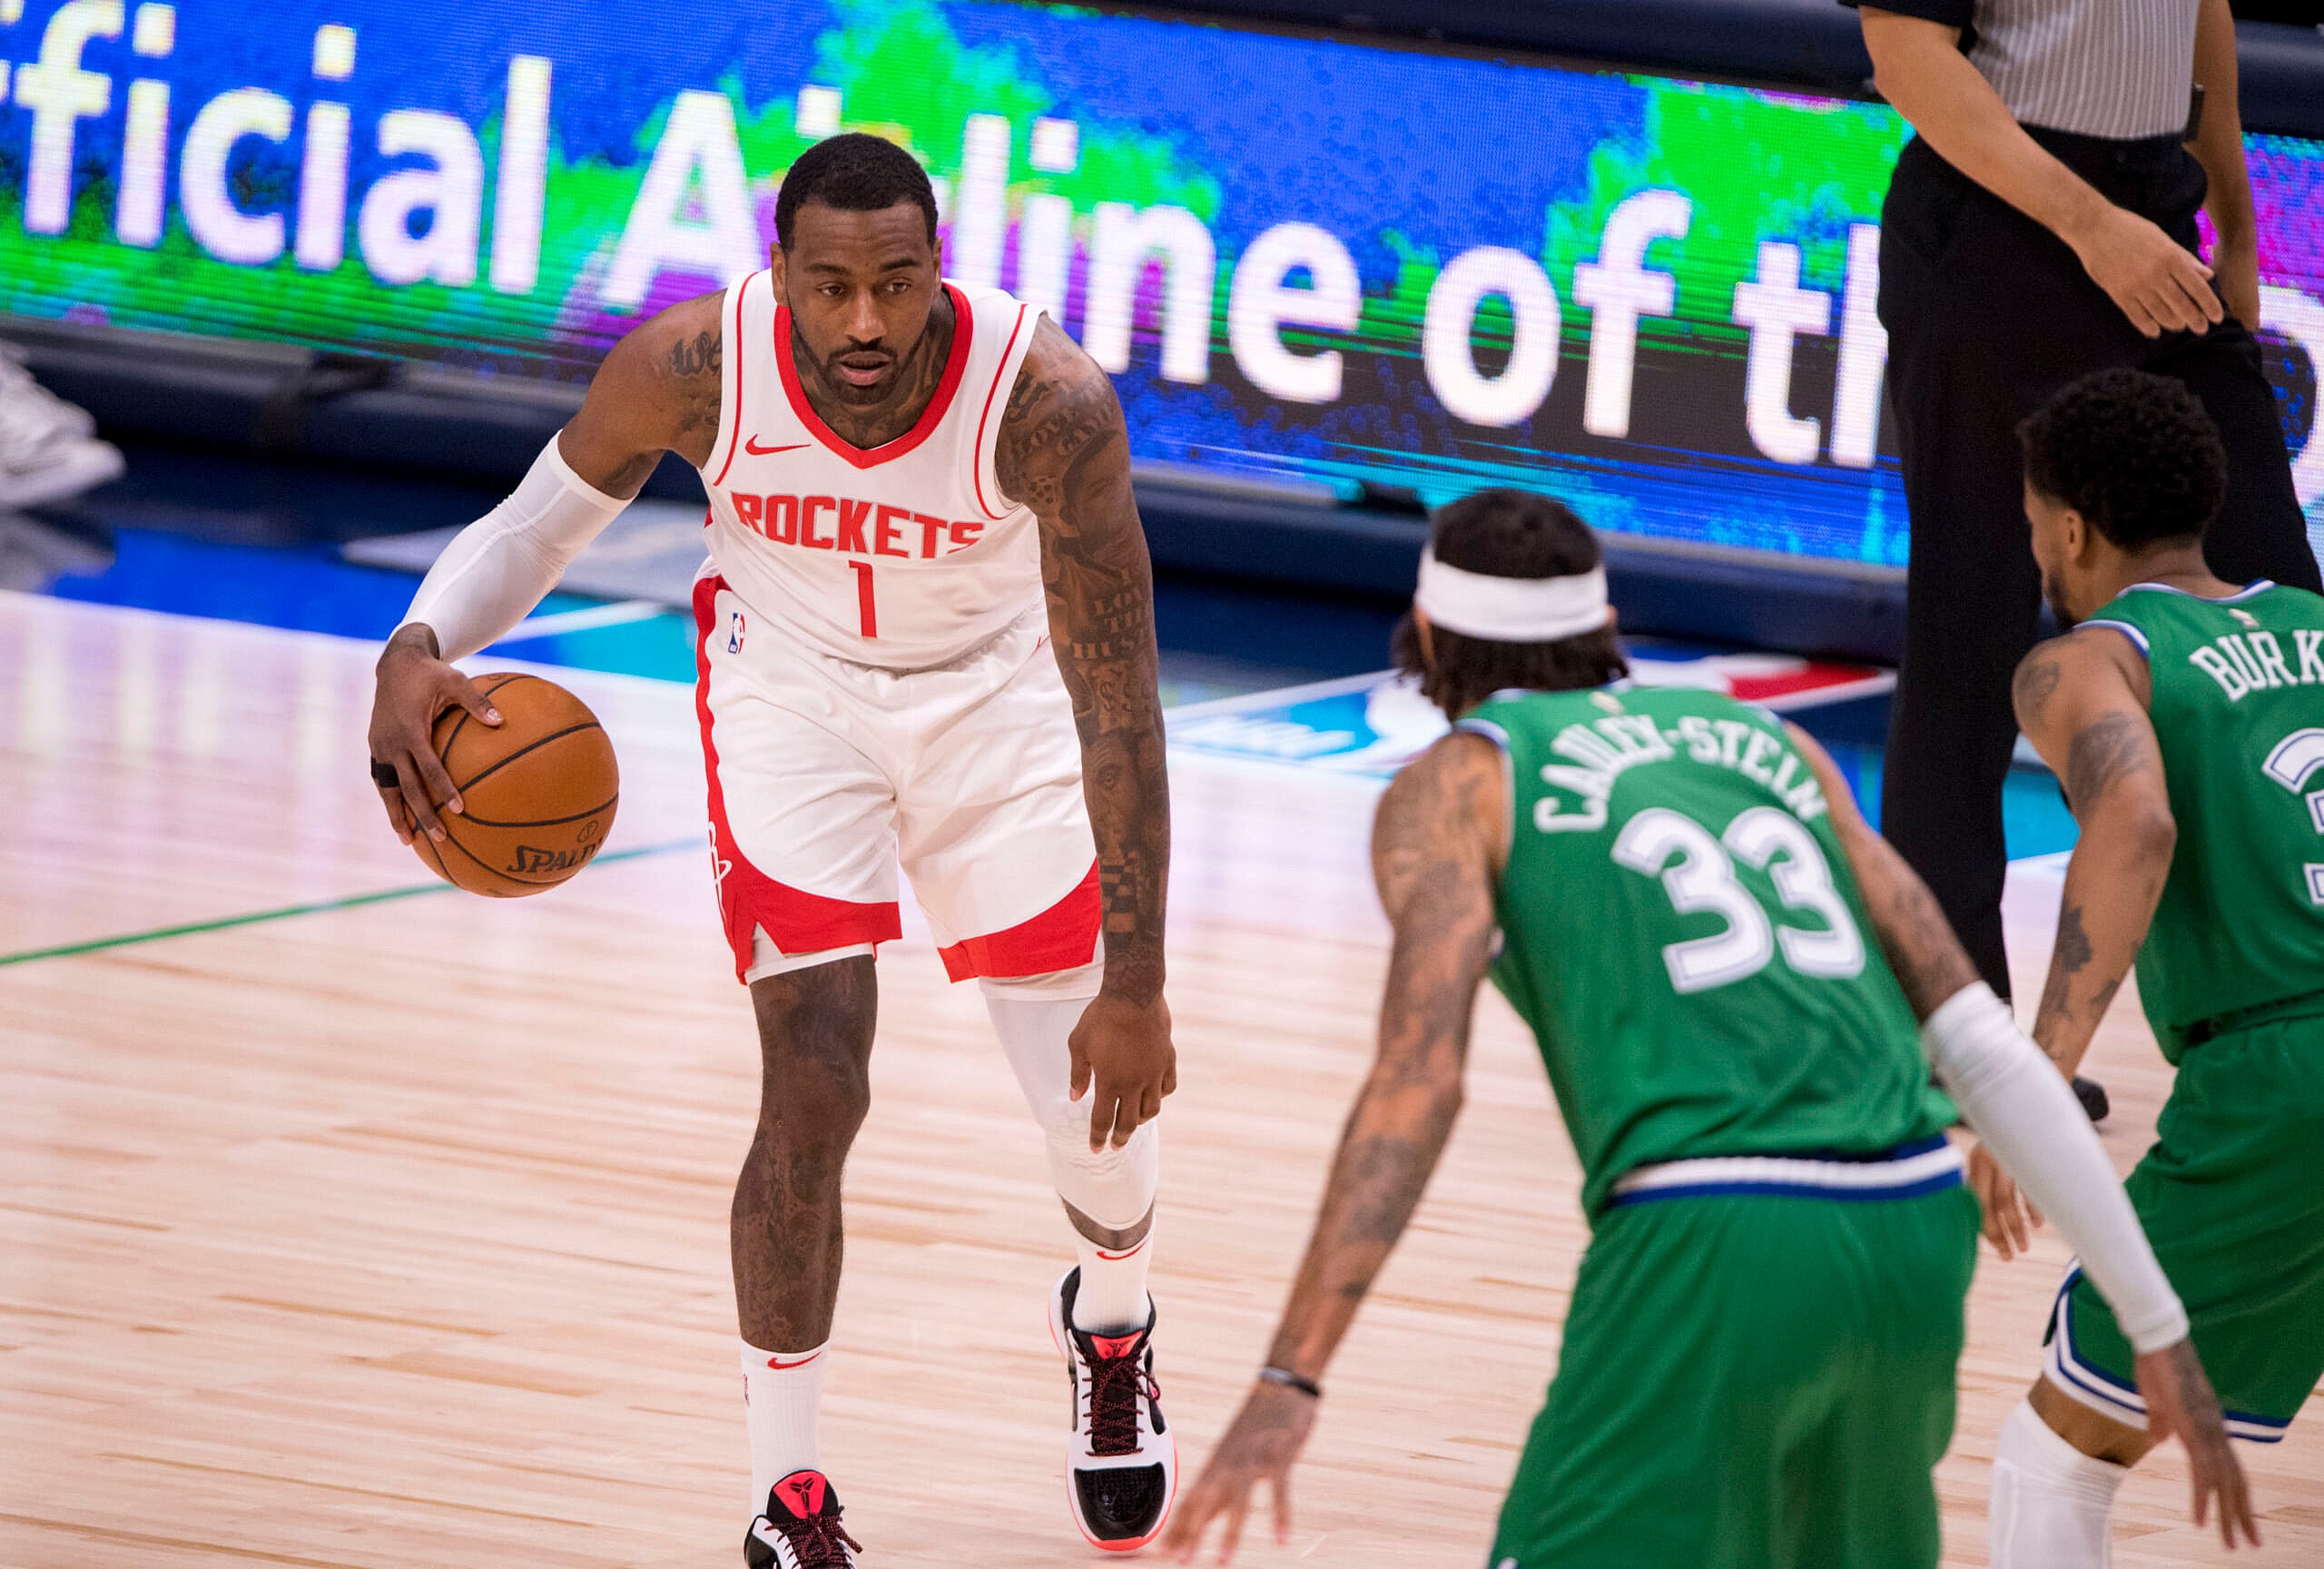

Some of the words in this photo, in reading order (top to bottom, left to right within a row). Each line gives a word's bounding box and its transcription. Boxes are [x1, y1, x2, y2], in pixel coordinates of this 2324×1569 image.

[0, 0, 552, 295] ficial
[599, 85, 1362, 403] Aline
[1423, 188, 1693, 439] of
[731, 491, 986, 559] ROCKETS
[848, 559, 878, 638] 1
[1533, 714, 1828, 833] CAULEY-STEIN
[507, 835, 604, 873] SPALD
[1610, 806, 1866, 995] 33
